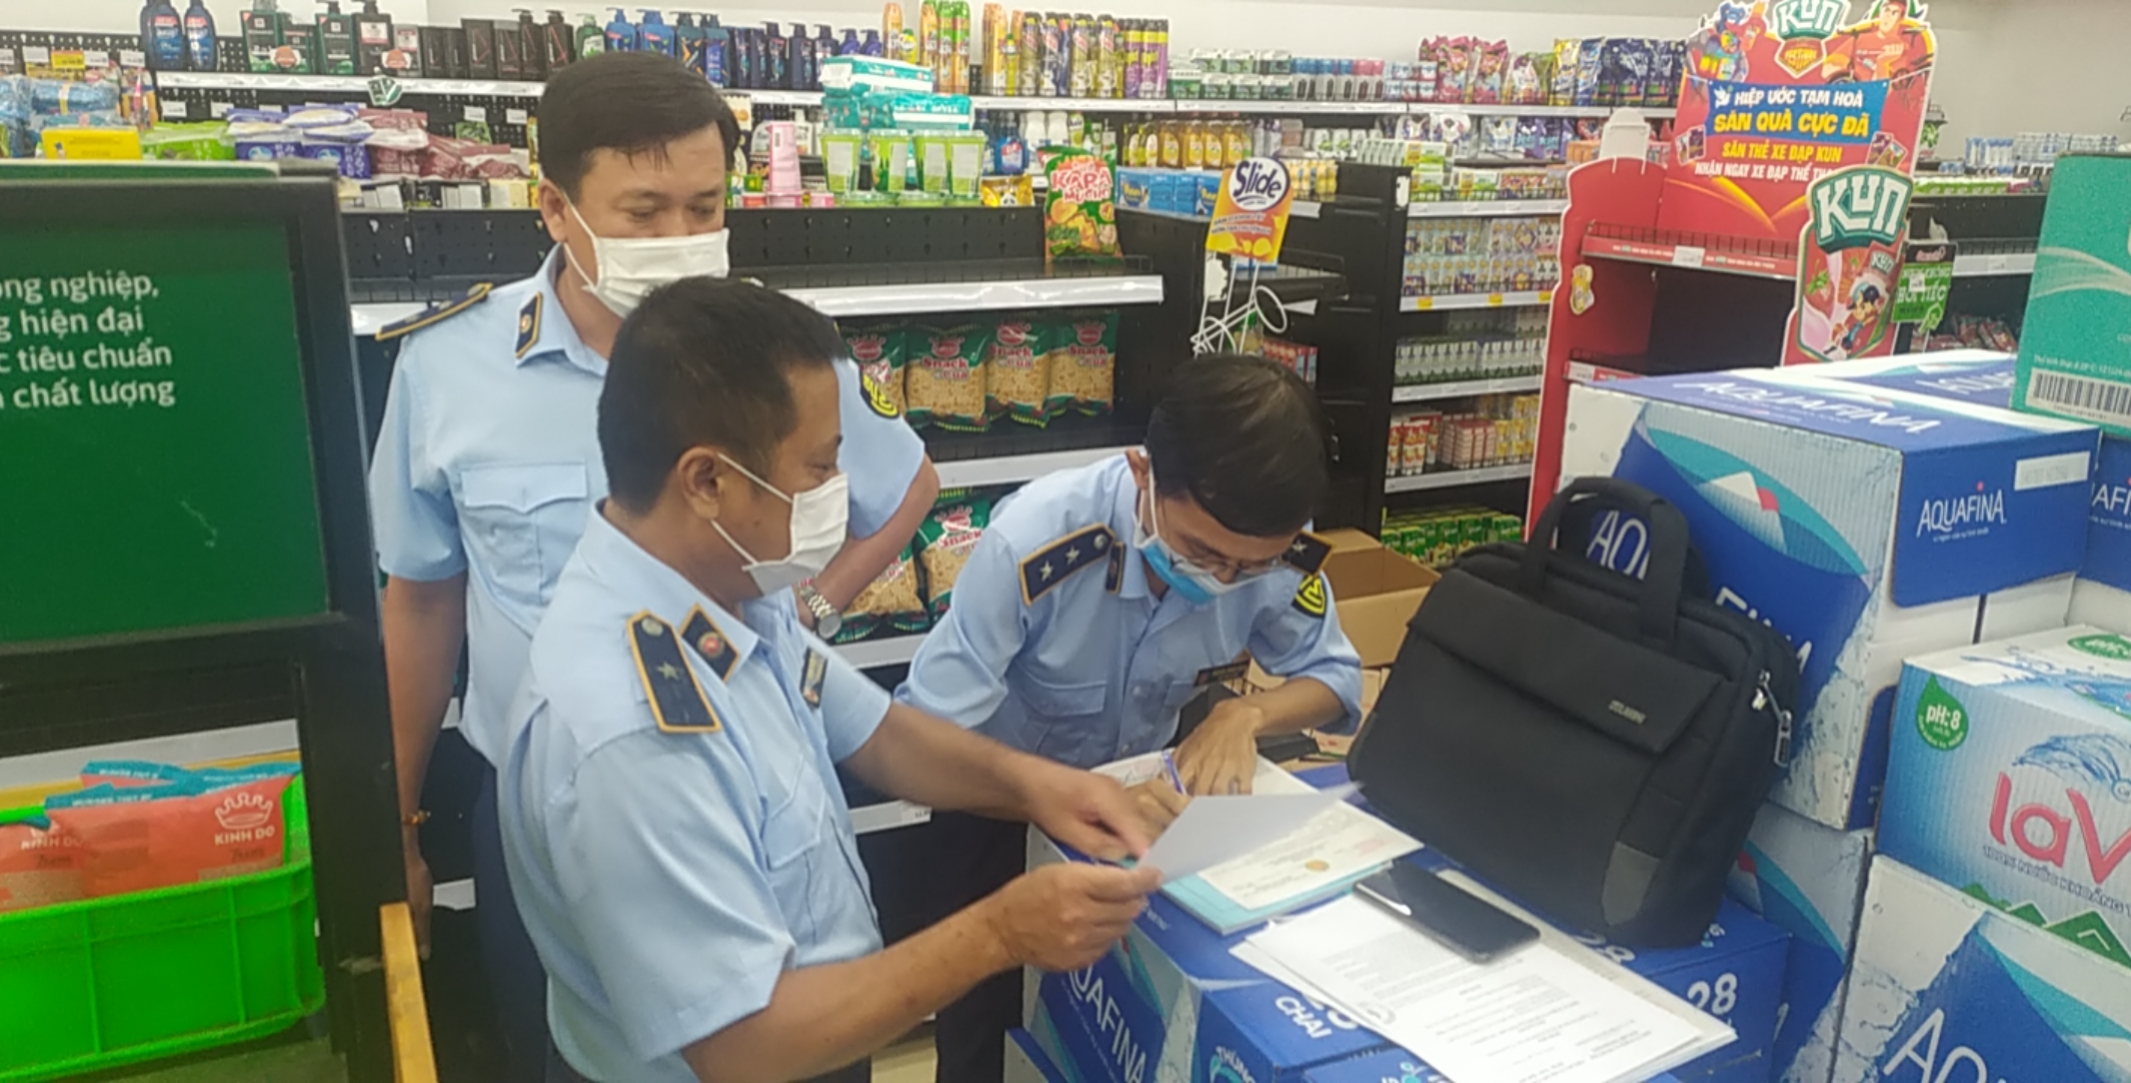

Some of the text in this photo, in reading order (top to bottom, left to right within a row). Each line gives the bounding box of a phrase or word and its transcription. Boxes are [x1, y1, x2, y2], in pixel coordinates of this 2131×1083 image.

[1779, 0, 1840, 33] KUN
[1800, 90, 1831, 108] TẠM
[1798, 112, 1838, 138] CỰC
[1724, 163, 1750, 178] NGAY
[1750, 165, 1766, 179] XE
[1771, 145, 1788, 160] XE
[1789, 145, 1814, 164] ĐẠP
[1815, 147, 1843, 163] KUN
[1233, 160, 1282, 198] Slide
[1817, 174, 1910, 240] KUN
[0, 270, 159, 305] ng nghiệp,
[20, 308, 89, 340] hiện
[97, 304, 144, 337] đại
[17, 345, 76, 373] tiêu
[82, 336, 173, 369] chuẩn
[922, 355, 969, 369] Snack
[1068, 343, 1108, 356] Snack
[13, 376, 176, 409] chất lượng
[1916, 488, 2005, 538] AQUAFINA
[214, 829, 253, 846] KINH
[1687, 972, 1738, 1015] 28
[1274, 995, 1333, 1039] CHAI
